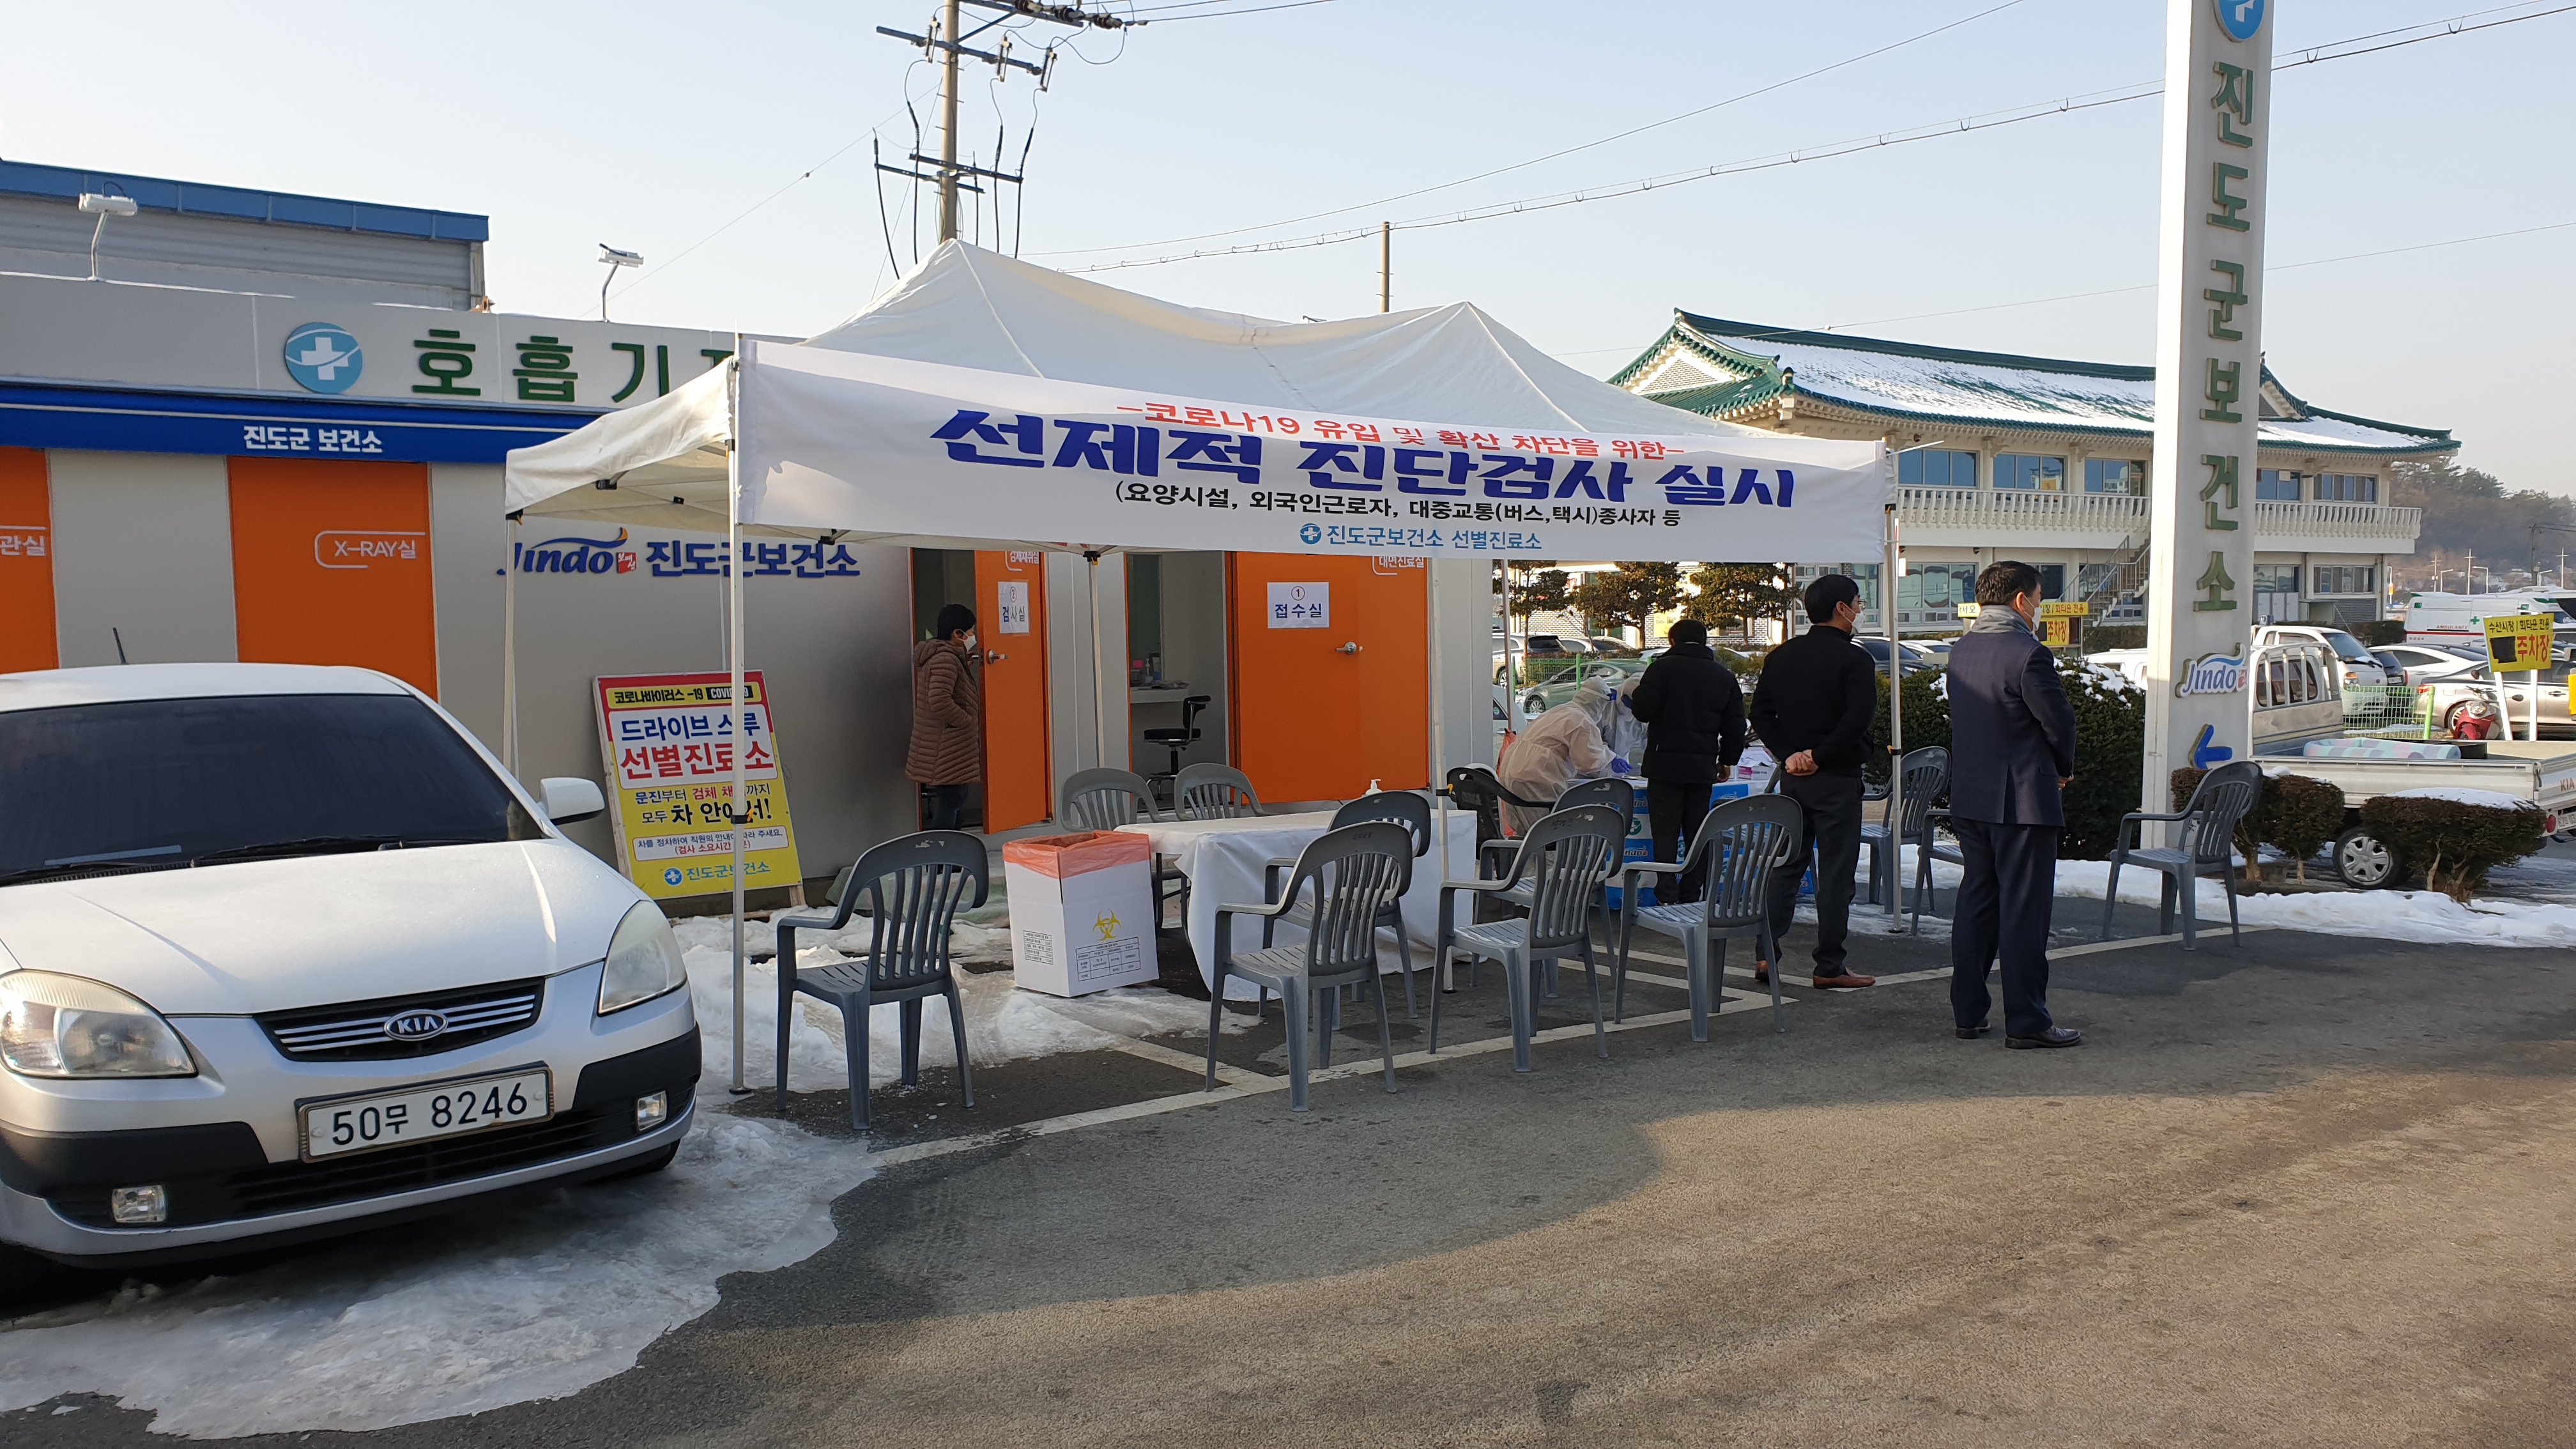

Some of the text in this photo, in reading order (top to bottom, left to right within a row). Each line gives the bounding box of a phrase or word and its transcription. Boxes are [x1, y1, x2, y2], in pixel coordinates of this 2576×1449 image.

[2193, 61, 2253, 611] 진도군보건소
[412, 328, 734, 402] 호흡기
[243, 425, 383, 453] 진도군 보건소
[1314, 420, 1381, 442] 유입
[1392, 427, 1426, 446] 및
[1436, 429, 1501, 450] 확산
[1511, 434, 1600, 457] 차단을
[930, 409, 1794, 507] 선제적 진단검사 실시
[1116, 480, 1238, 510] (요양시설,
[1250, 491, 1398, 518] 외국인근로자,
[1662, 510, 1681, 526] 등
[334, 539, 417, 559] X-RAY실
[1326, 525, 1543, 550] 진도군보건소 선별진료소
[496, 542, 615, 575] Jindo
[645, 540, 861, 578] 진도군보건소
[1379, 556, 1425, 568] 대면진료실
[1002, 606, 1025, 622] 검사실
[1275, 603, 1322, 618] 접수실
[2055, 604, 2071, 613] 회타운
[2073, 604, 2084, 613] 전용
[2048, 620, 2067, 643] 주차장
[2488, 619, 2514, 633] 수산시장
[2520, 620, 2538, 631] 회타운
[2539, 618, 2549, 631] 전용
[2517, 634, 2550, 663] 주차장
[2182, 663, 2237, 693] Jindo
[614, 689, 685, 704] 코로나바이러스
[710, 687, 749, 699] COVI9
[621, 713, 760, 741] 드라이브 스루
[620, 741, 774, 779] 선별진료소
[635, 783, 770, 804] 문진부터 검체 채까지
[2560, 778, 2575, 792] KIA
[642, 810, 668, 824] 모두
[671, 804, 693, 825] 차
[638, 839, 654, 848] 차를
[656, 837, 687, 847] 정차하여
[691, 835, 713, 844] 직원의
[758, 829, 783, 838] 주세요.
[675, 845, 695, 855] (검사
[698, 842, 732, 853] 소요시간
[397, 1016, 440, 1035] KIA
[332, 1082, 528, 1146] 50무 8246
